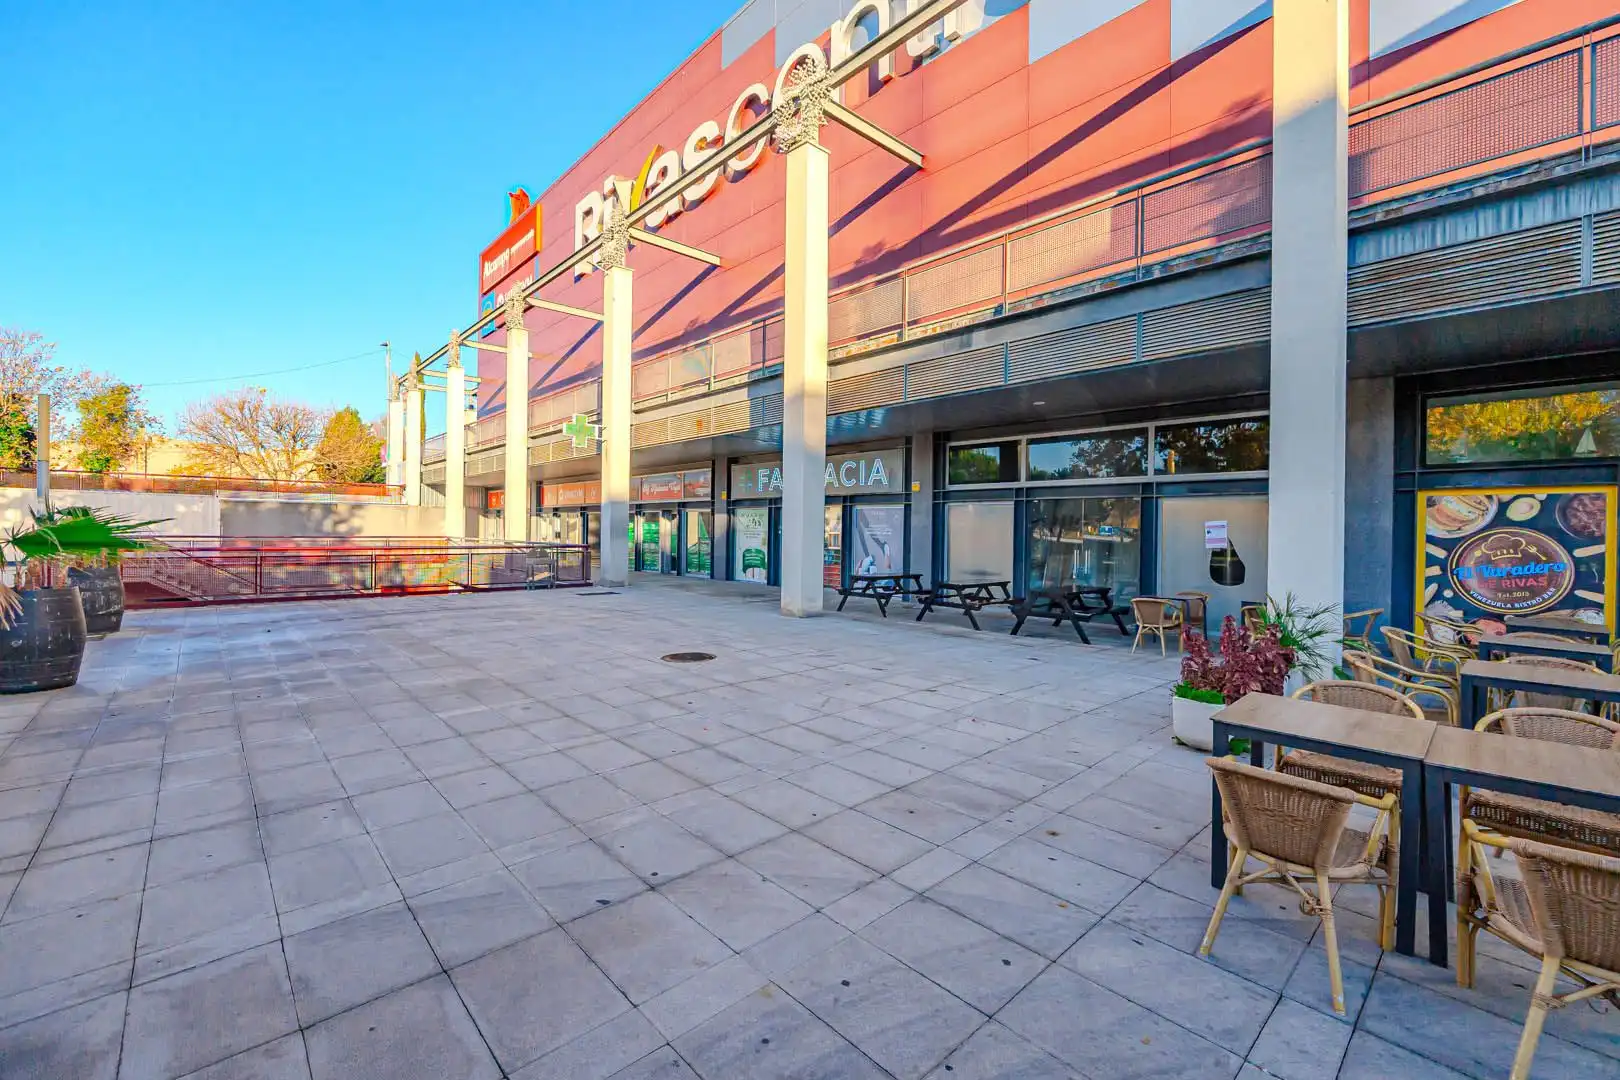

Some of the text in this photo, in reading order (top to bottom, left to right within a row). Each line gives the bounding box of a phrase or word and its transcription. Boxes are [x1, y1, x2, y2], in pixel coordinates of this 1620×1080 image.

[757, 457, 889, 493] FAACIA
[1502, 576, 1549, 589] RIVAS
[1470, 590, 1512, 608] VENEZUELA
[1543, 587, 1557, 600] BAR
